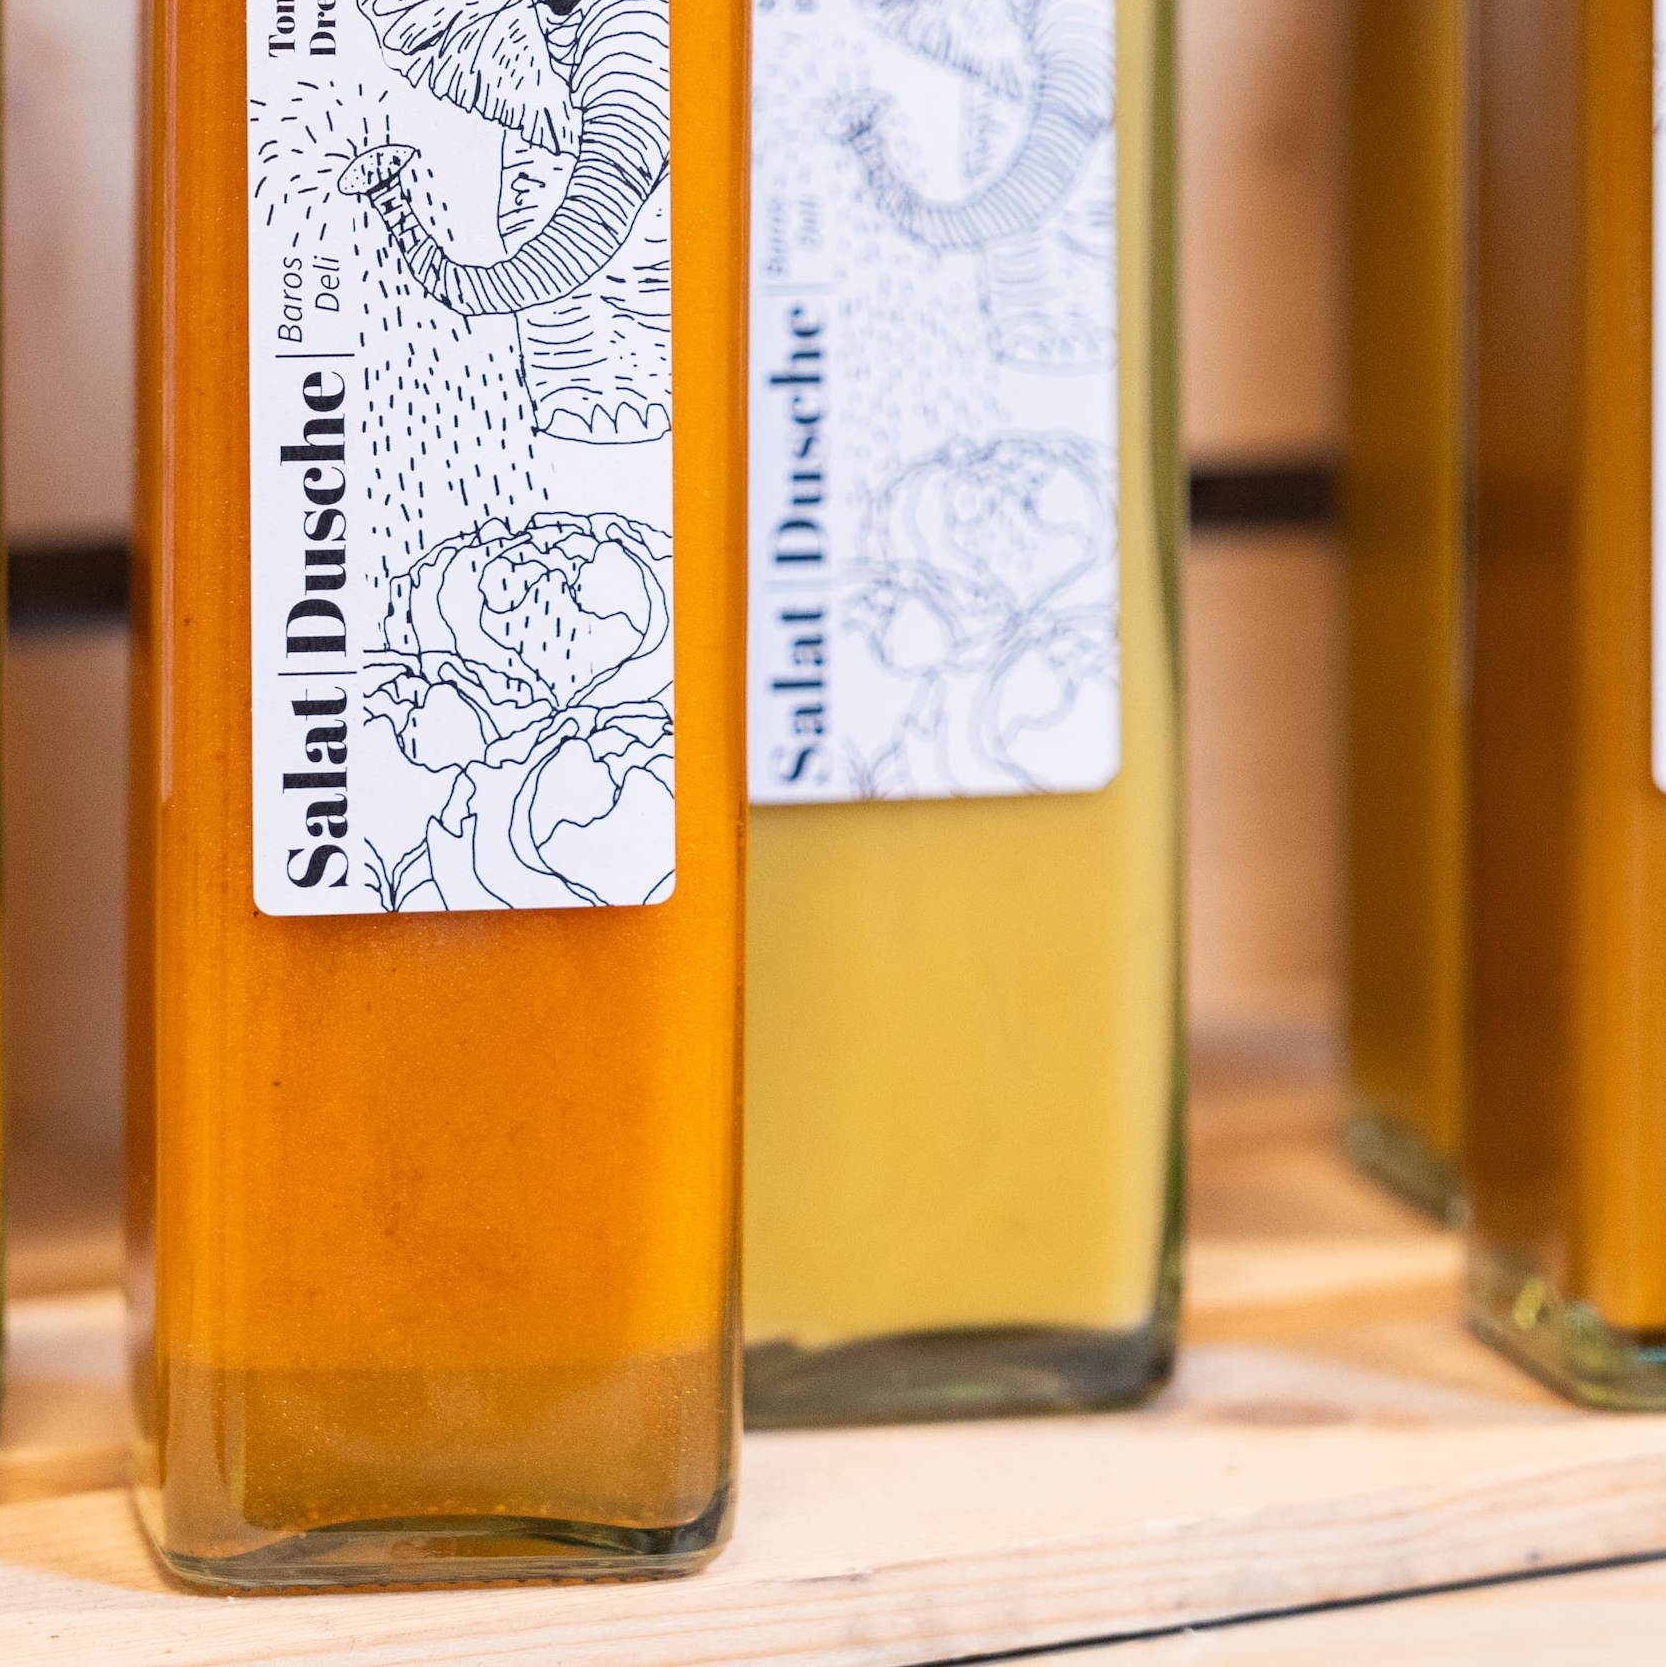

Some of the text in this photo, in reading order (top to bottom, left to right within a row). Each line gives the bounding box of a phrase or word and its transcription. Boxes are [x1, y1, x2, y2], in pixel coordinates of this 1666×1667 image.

[278, 257, 302, 343] Baros
[313, 255, 340, 312] Deli
[768, 307, 825, 565] Dusche
[280, 372, 349, 888] Salat Dusche
[770, 608, 826, 783] Salat
